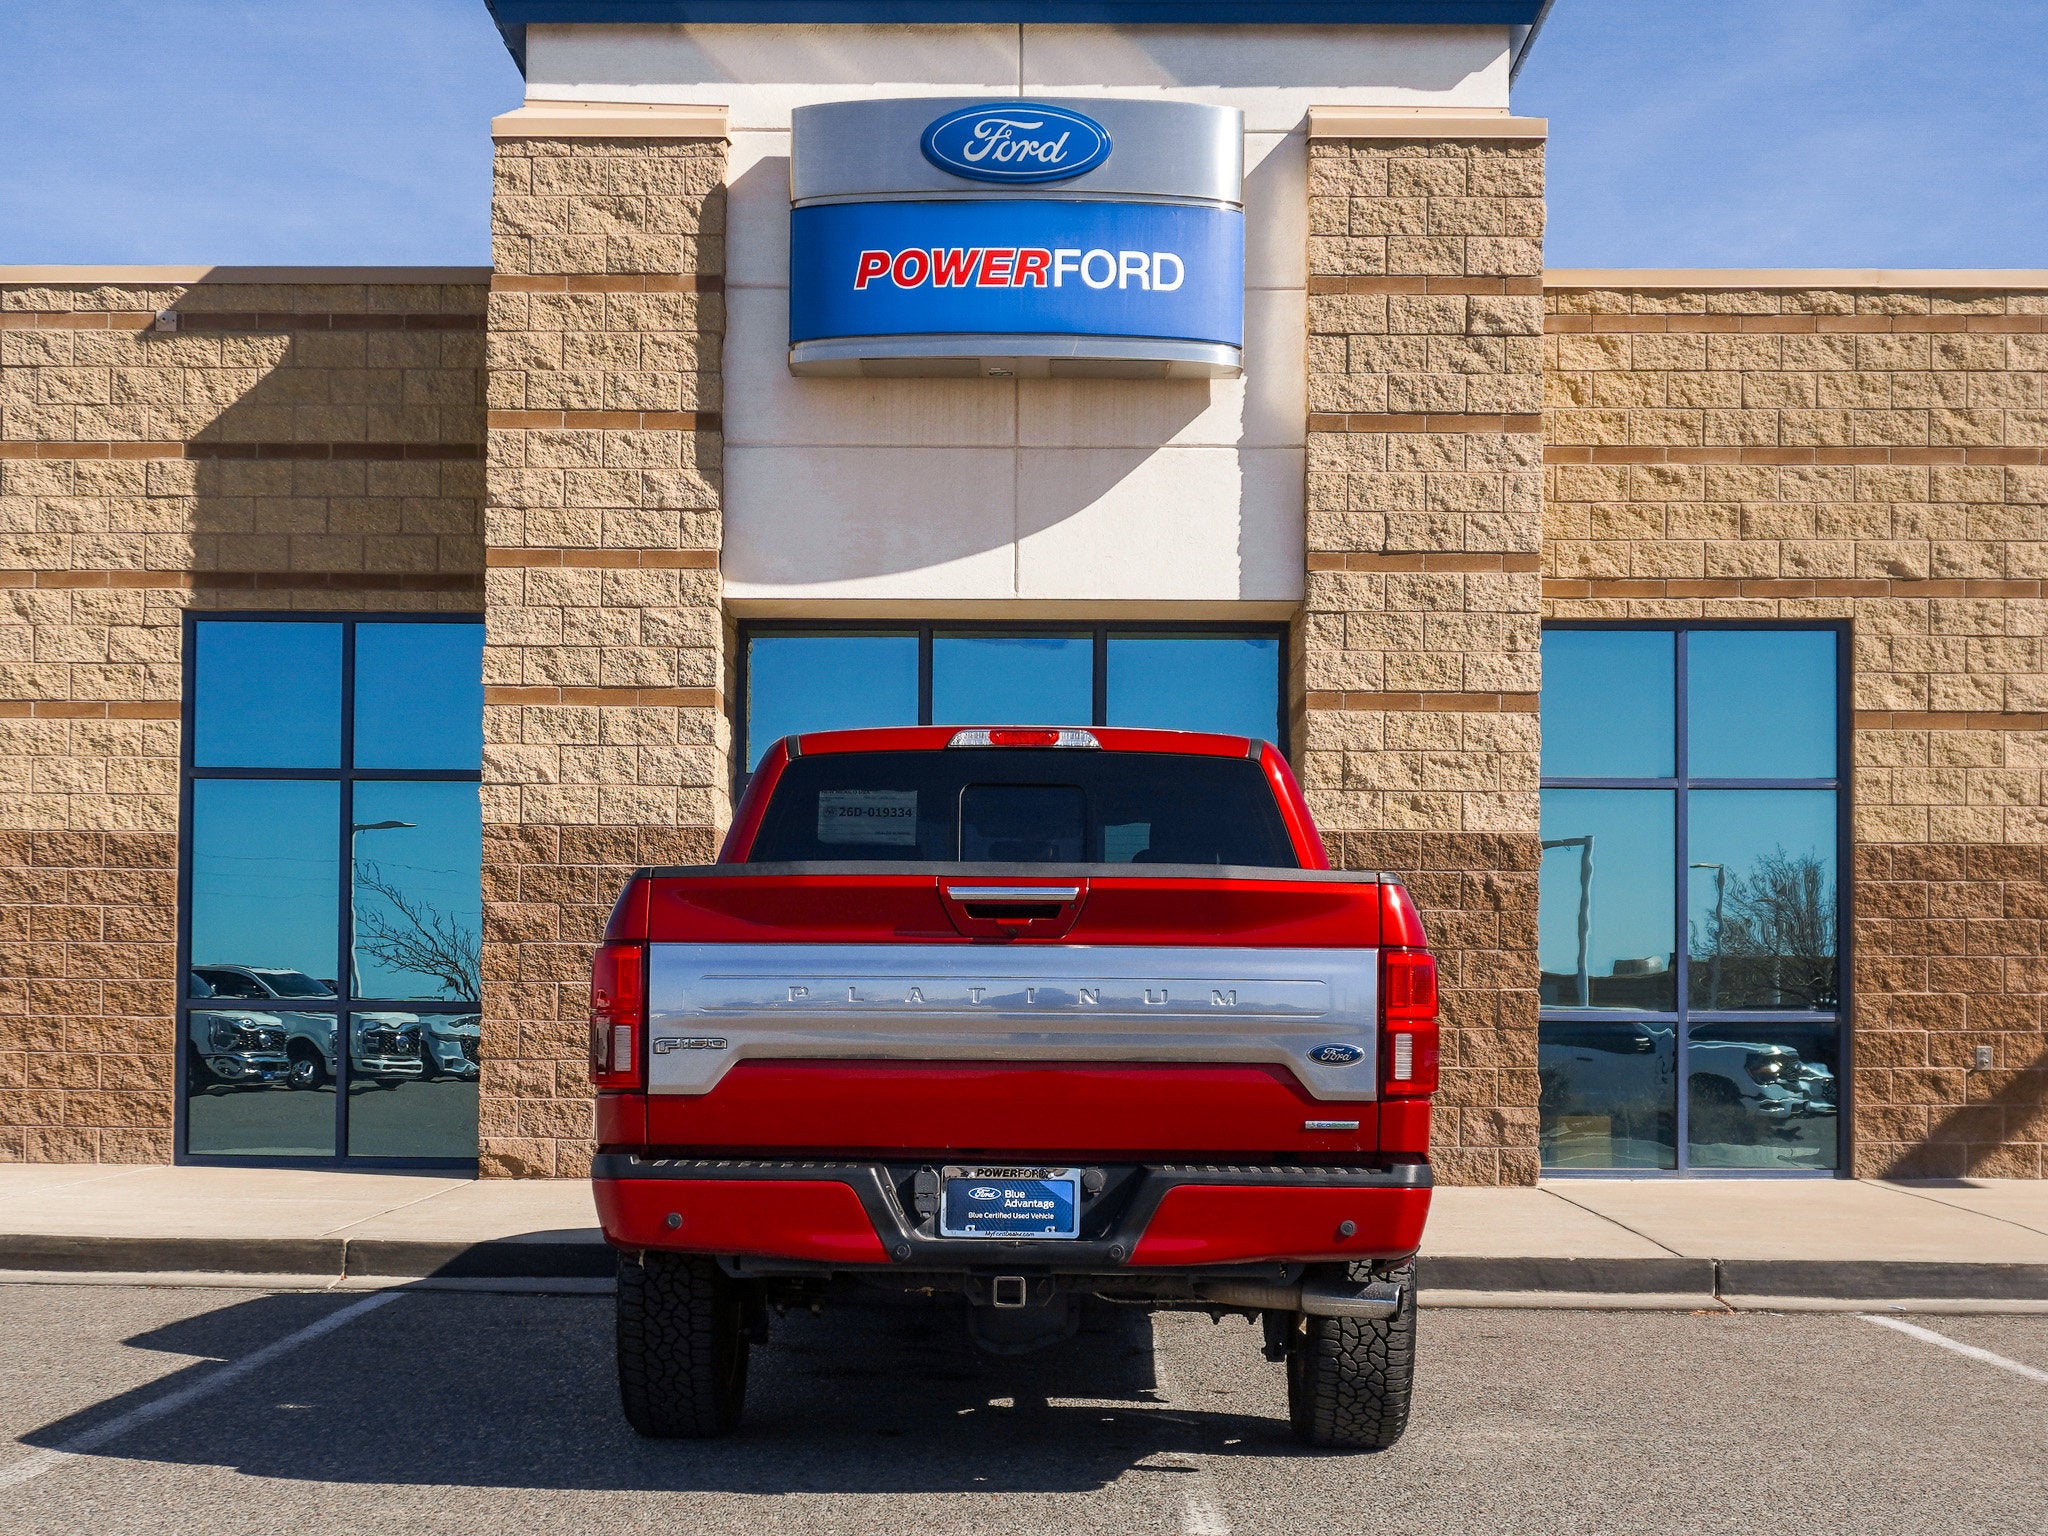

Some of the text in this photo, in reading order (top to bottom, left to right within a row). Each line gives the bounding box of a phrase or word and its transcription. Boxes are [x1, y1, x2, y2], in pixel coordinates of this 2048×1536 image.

[962, 118, 1071, 163] Ford
[853, 247, 1185, 291] POWERFORD
[838, 806, 913, 818] 26D-019334
[787, 985, 1238, 1007] PLATINUM
[1320, 1047, 1352, 1061] Ford
[974, 1187, 996, 1198] Ford
[1004, 1190, 1026, 1199] Blue
[1004, 1199, 1055, 1210] Advantage
[968, 1211, 983, 1219] Blue
[983, 1211, 1012, 1219] Certified
[1031, 1212, 1055, 1220] Vehicle
